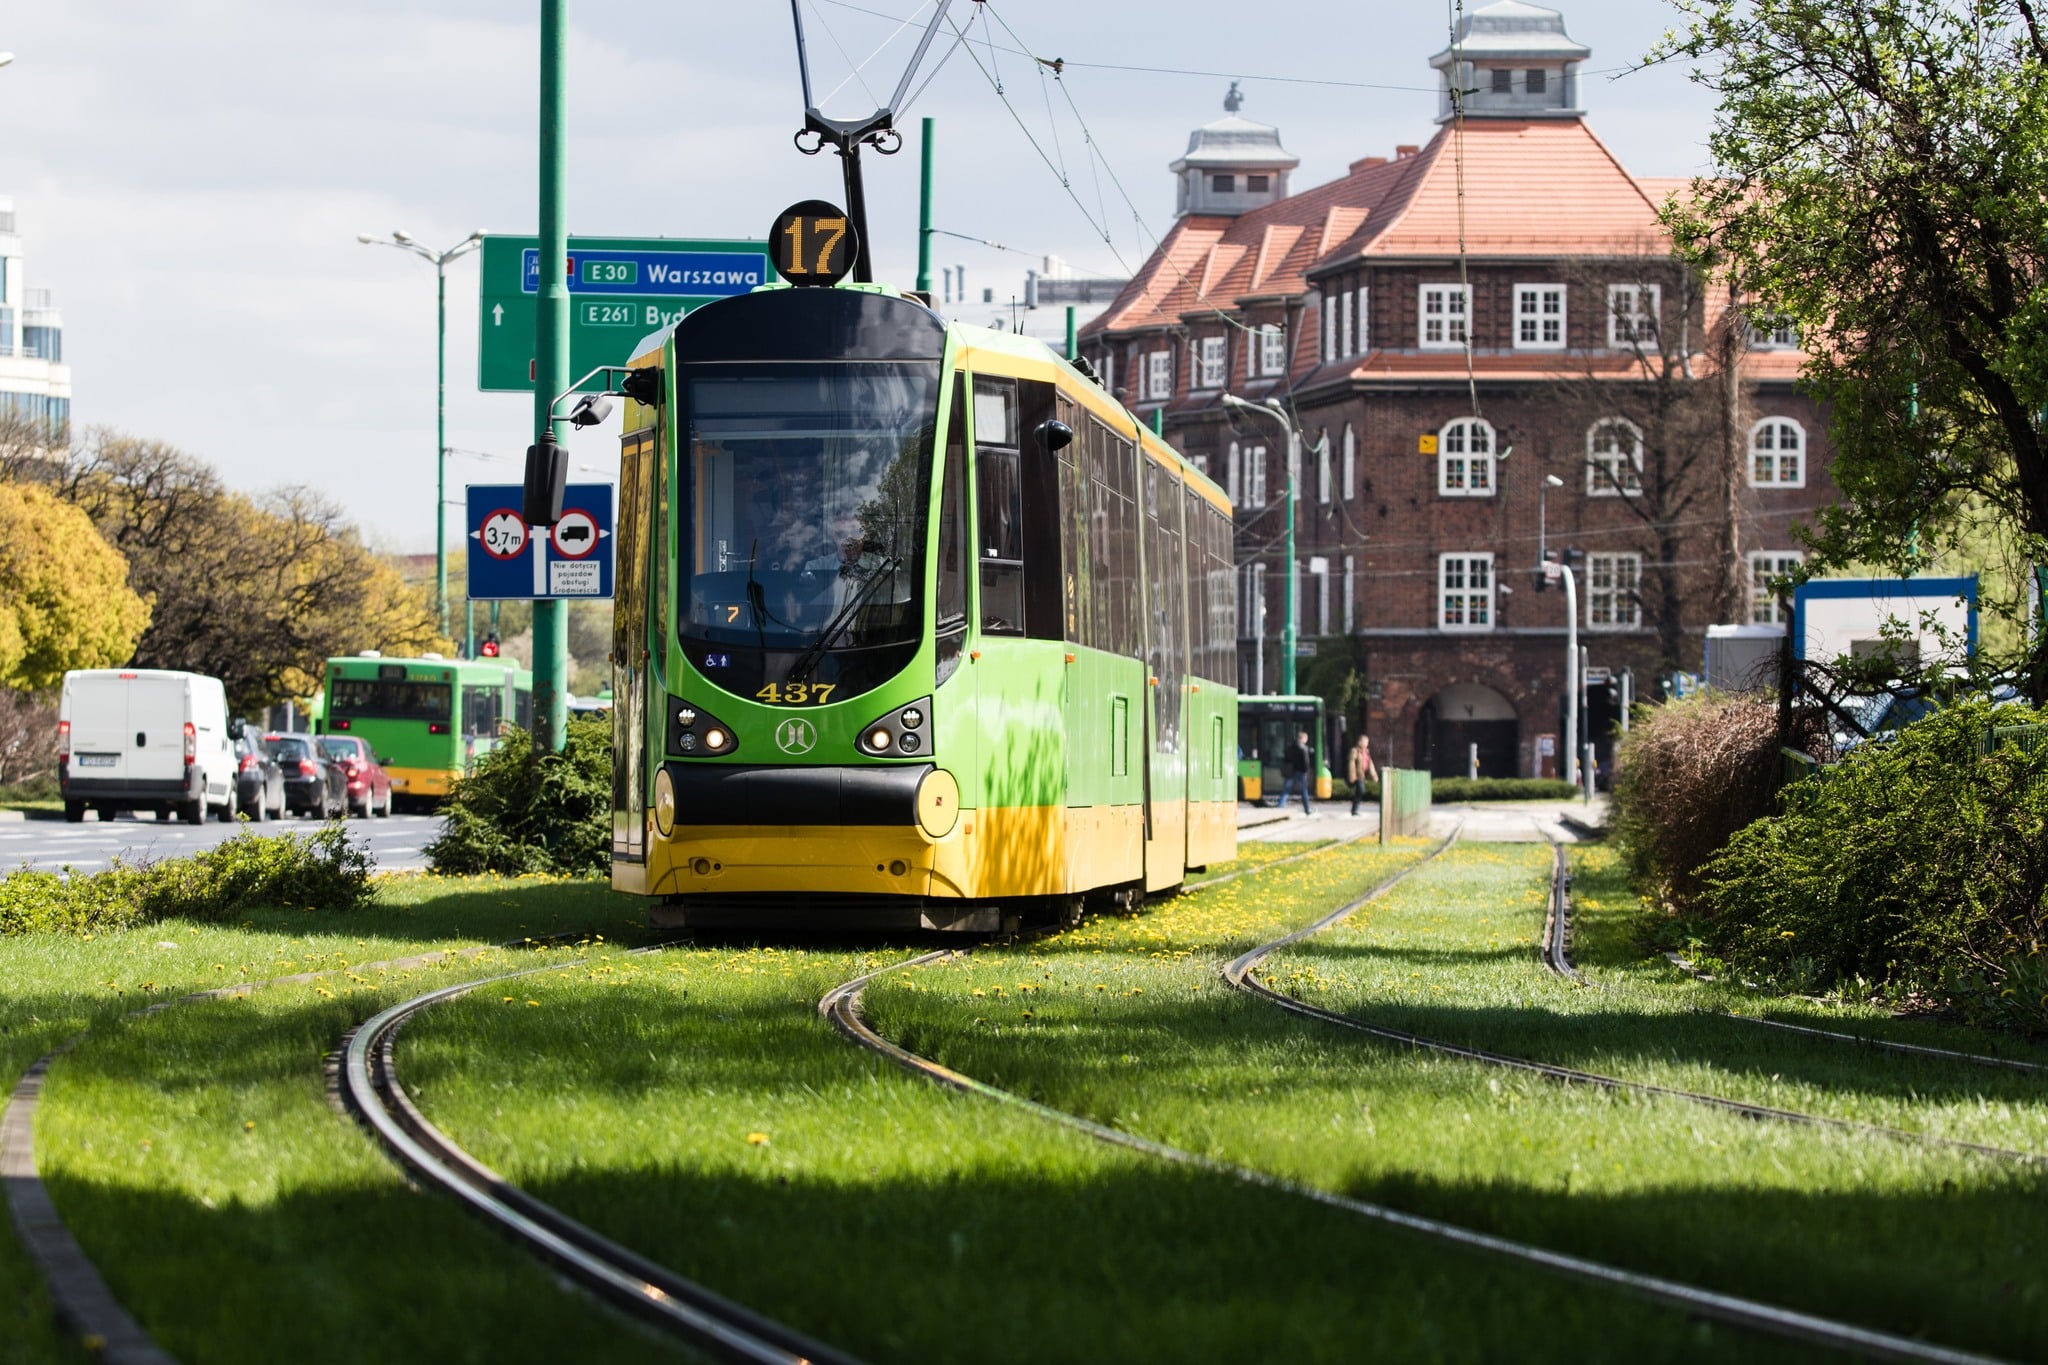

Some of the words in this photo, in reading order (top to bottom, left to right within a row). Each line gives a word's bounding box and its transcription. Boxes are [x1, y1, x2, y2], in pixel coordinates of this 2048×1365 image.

[784, 216, 846, 274] 17
[591, 264, 602, 281] E
[605, 265, 628, 281] 30
[647, 264, 758, 285] Warszawa
[588, 306, 599, 322] E
[601, 306, 629, 323] 261
[756, 682, 837, 704] 437
